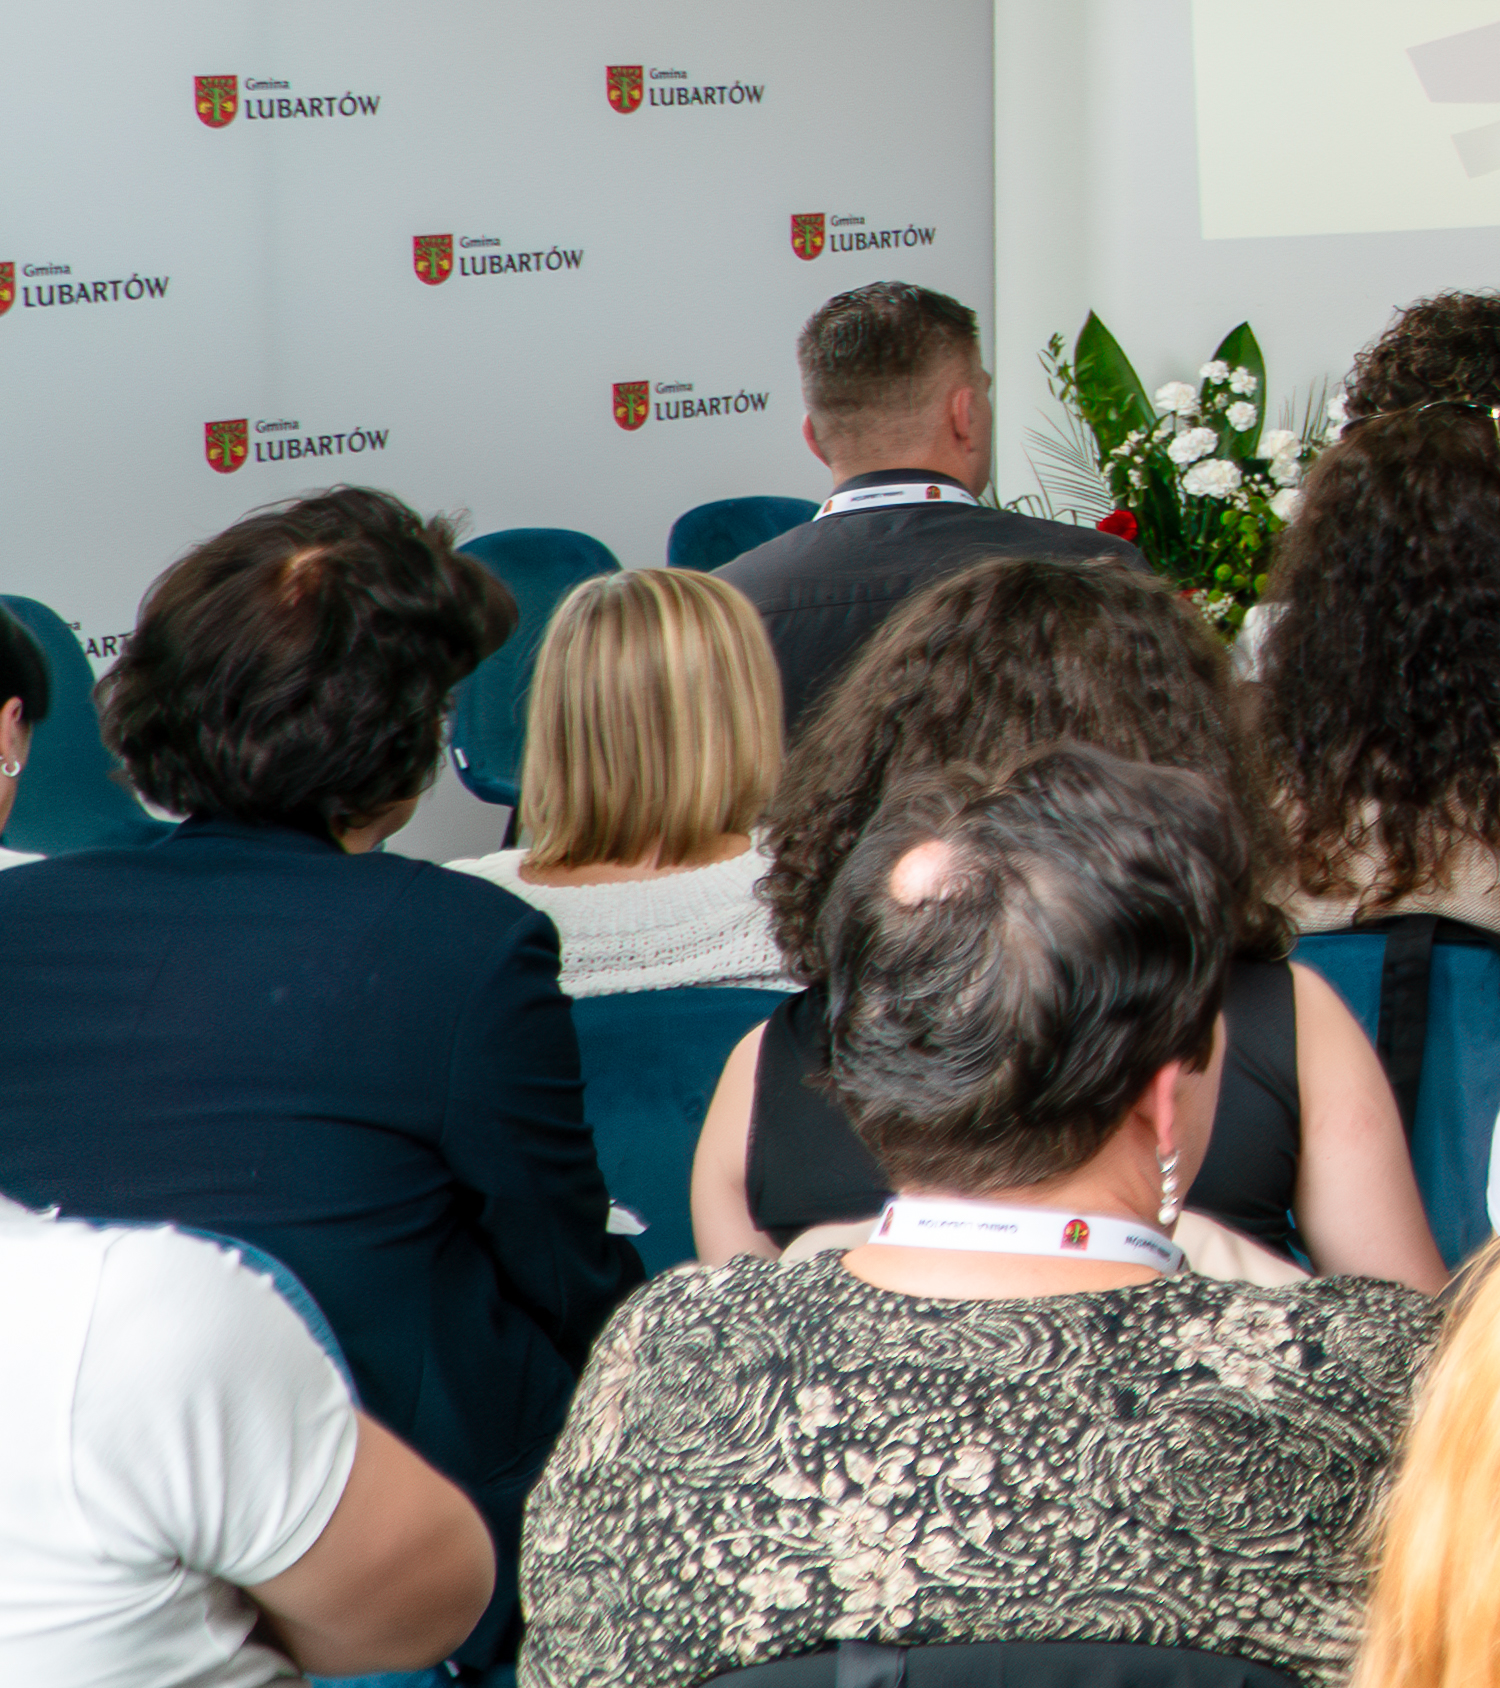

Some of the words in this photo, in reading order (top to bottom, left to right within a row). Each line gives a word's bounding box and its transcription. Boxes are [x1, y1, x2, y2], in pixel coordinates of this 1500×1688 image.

[244, 77, 290, 91] Gmina
[648, 67, 688, 80] Gmina
[648, 80, 764, 107] LUBARTÓW
[244, 93, 380, 120] LUBARTÓW
[829, 214, 866, 228] Gmina
[458, 235, 501, 249] Gmina
[829, 223, 936, 253] LUBARTÓW
[21, 263, 72, 278] Gmina
[459, 247, 584, 277] LUBARTÓW
[22, 274, 169, 308] LUBARTÓW
[654, 381, 694, 395] Gmina
[654, 388, 769, 422] LUBARTÓW
[254, 419, 300, 434] Gmina
[254, 427, 389, 463] LUBARTÓW
